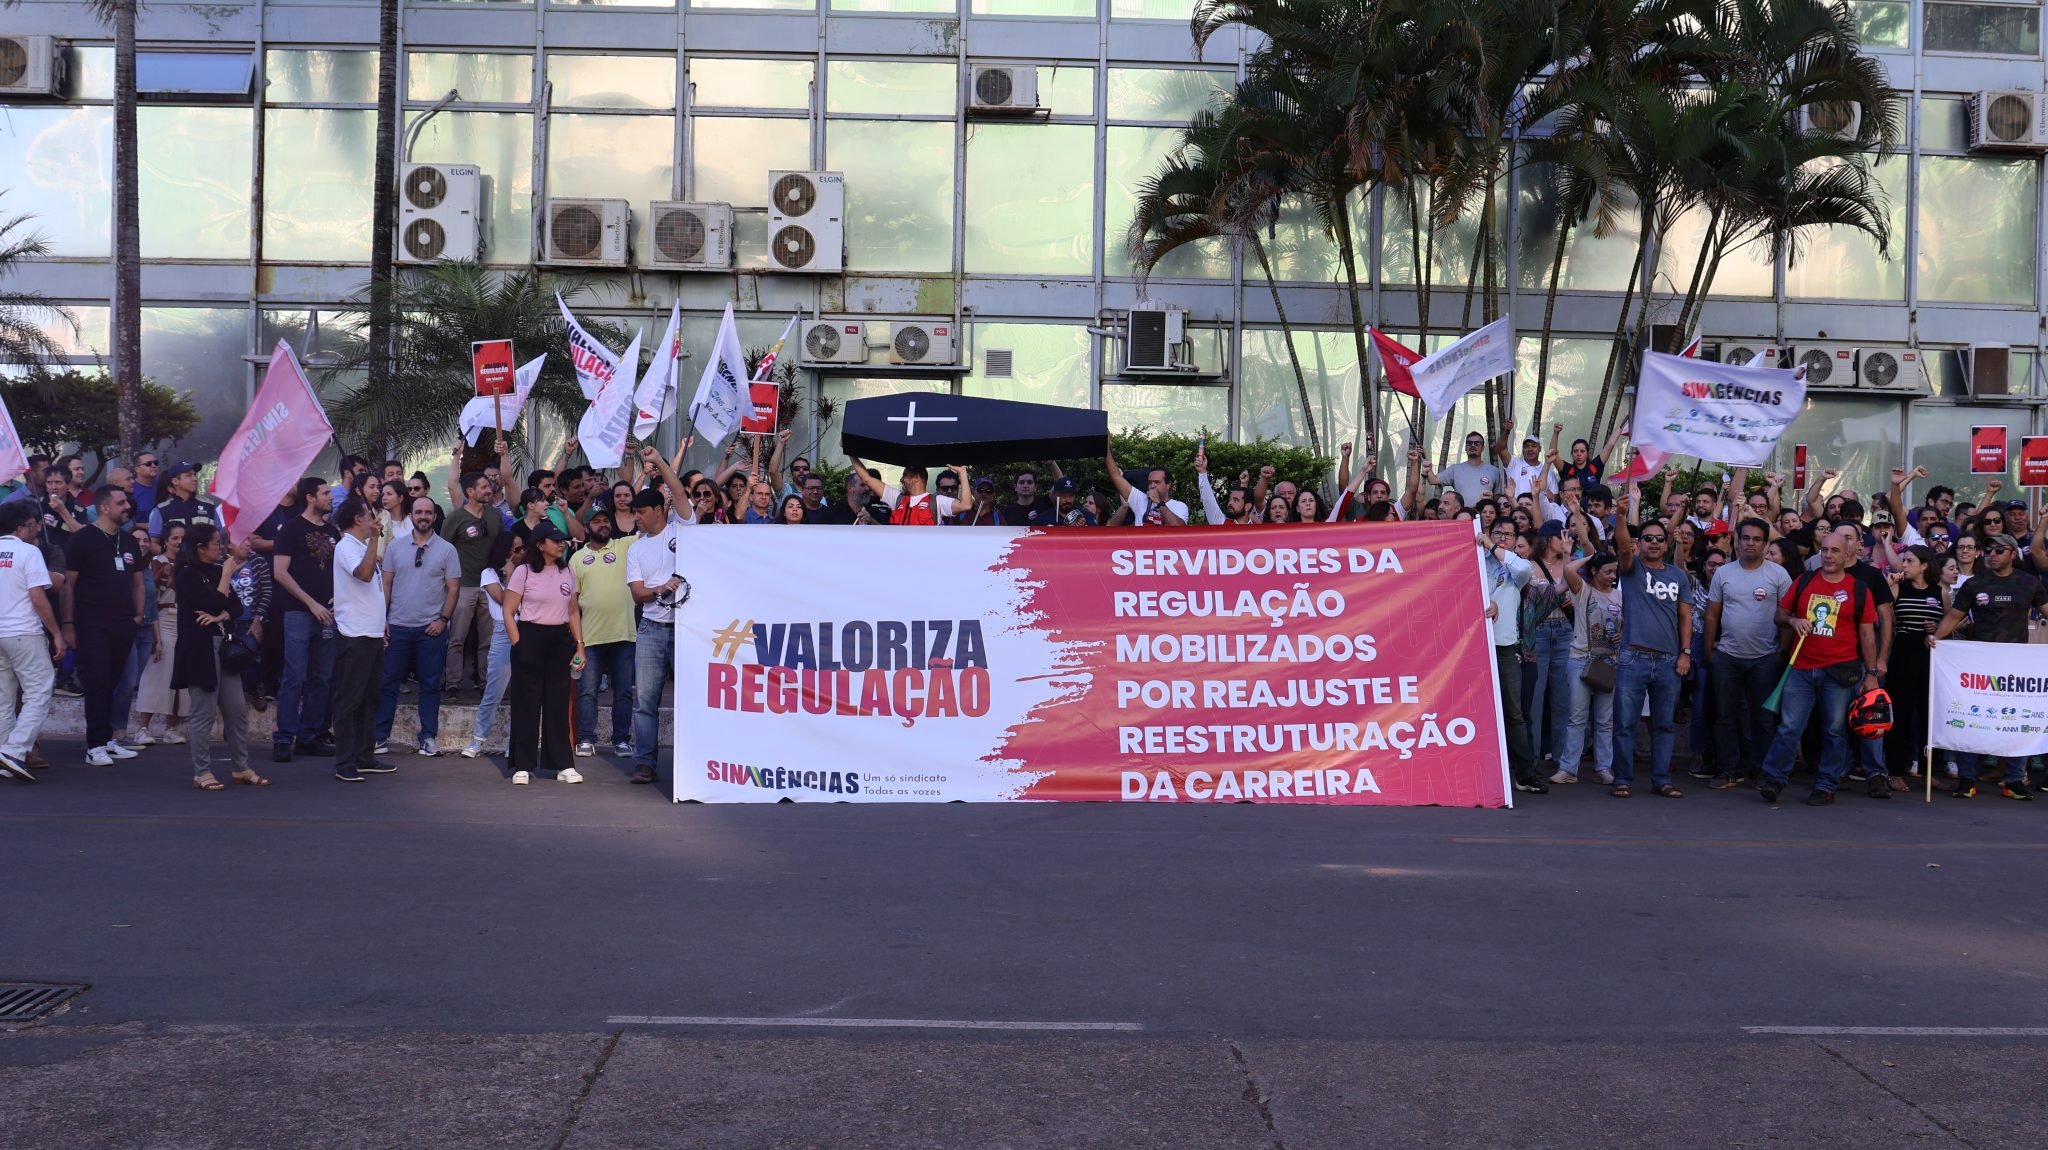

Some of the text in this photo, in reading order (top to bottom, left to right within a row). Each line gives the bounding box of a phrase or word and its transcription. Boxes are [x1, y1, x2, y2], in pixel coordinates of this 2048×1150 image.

[1111, 547, 1404, 576] SERVIDORES DA
[1645, 571, 1680, 602] Lee
[1114, 582, 1346, 628] REGULAÇÃO
[711, 618, 988, 673] #VALORIZA
[1116, 634, 1377, 663] MOBILIZADOS
[1812, 627, 1833, 637] LUTA
[707, 657, 991, 728] REGULAÇÃO
[1117, 680, 1196, 709] POR
[1203, 677, 1393, 708] REAJUSTE
[1399, 675, 1419, 704] E
[2030, 711, 2045, 719] ANS
[1119, 713, 1476, 760] REESTRUTURAÇÃO
[707, 760, 947, 794] SINAGÊNCIAS Um só sindicato
[863, 786, 941, 796] Todas as vozes
[1121, 771, 1179, 801] DA
[1184, 768, 1382, 799] CARREIRA
